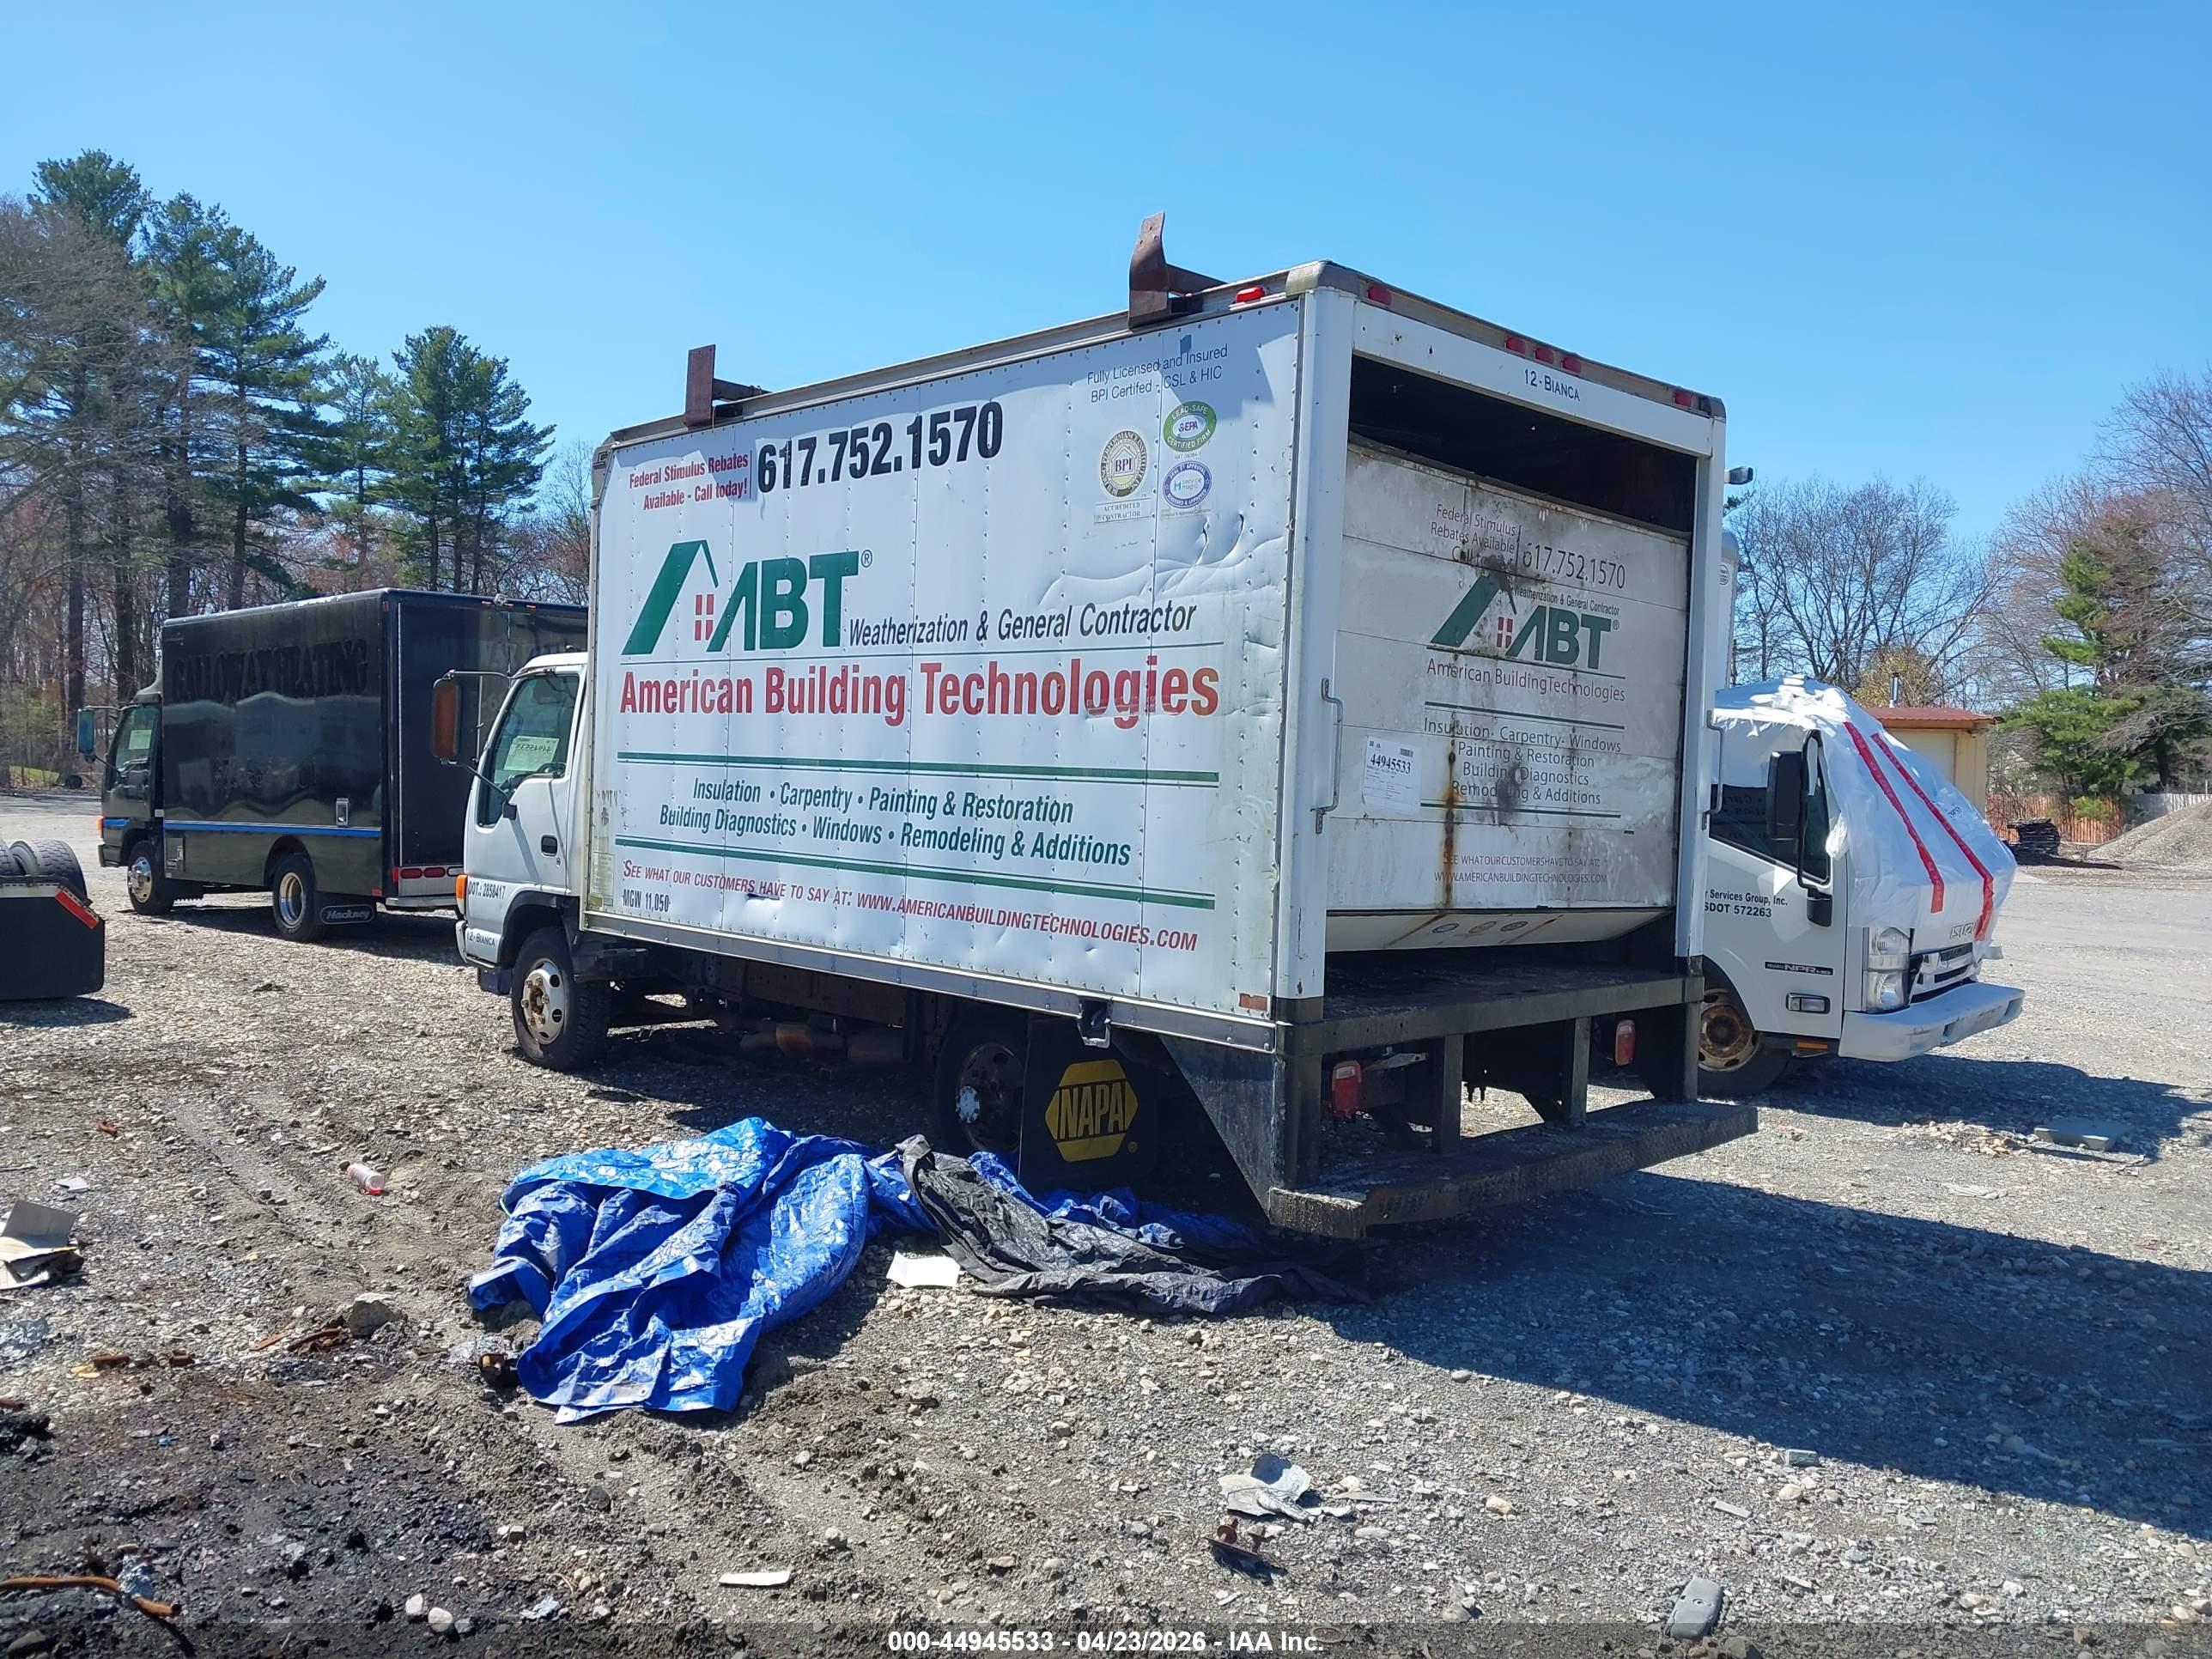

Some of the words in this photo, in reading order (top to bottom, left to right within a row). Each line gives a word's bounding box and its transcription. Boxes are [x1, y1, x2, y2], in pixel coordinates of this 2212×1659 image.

[1086, 371, 1110, 386] Fully
[1112, 359, 1160, 380] Licensed
[1164, 355, 1182, 370] and
[1185, 343, 1228, 366] Insured
[1091, 388, 1109, 404] BPI
[1164, 374, 1185, 389] CSL
[1188, 370, 1198, 384] &
[1200, 366, 1222, 382] HIC
[1171, 404, 1209, 420] LEAD-SAFE
[757, 401, 1004, 494] 617.752.1570
[1167, 435, 1196, 449] CERTIFIED
[1196, 428, 1211, 446] FIRM
[629, 468, 662, 489] Federal
[664, 459, 705, 483] Stimulus
[708, 453, 749, 474] Rebates
[1115, 458, 1132, 472] BPI
[643, 489, 684, 511] Available
[695, 483, 713, 502] Call
[715, 477, 748, 500] today!
[1103, 502, 1140, 513] ACCREDITED
[1102, 511, 1140, 521] CONTRACTOR
[1436, 503, 1473, 526] Federal
[1474, 514, 1516, 537] Stimulus
[1430, 521, 1469, 544] Rebates
[1471, 532, 1515, 554] Available
[1522, 542, 1626, 589] 617.752.1570
[1514, 585, 1559, 605] Weatherization
[1560, 593, 1565, 605] &
[1566, 594, 1589, 611] General
[1590, 600, 1620, 617] Contractor
[849, 612, 969, 647] Weatherization
[975, 610, 988, 641] &
[998, 605, 1073, 641] General
[1079, 600, 1198, 637] Contractor
[1426, 658, 1491, 684] American
[619, 669, 753, 714] American
[765, 664, 906, 727] Building
[920, 654, 1219, 729] Technologies
[1499, 726, 1561, 750] Carpentry
[1569, 733, 1622, 753] Windows
[1370, 752, 1411, 775] 44945533
[1458, 741, 1511, 762] Painting
[1514, 747, 1524, 761] &
[1527, 748, 1595, 769] Restoration
[1520, 766, 1589, 786] Diagnostics
[693, 777, 762, 804] Insulation
[780, 781, 853, 815] Carpentry
[868, 787, 938, 820] Painting
[943, 791, 957, 817] &
[962, 792, 1074, 824] Restoration
[1533, 786, 1542, 800] &
[1545, 787, 1601, 805] Additions
[659, 804, 711, 835] Building
[714, 808, 797, 837] Diagnostics
[812, 815, 883, 845] Windows
[901, 822, 1006, 860] Remodeling
[1010, 830, 1025, 857] &
[1030, 831, 1132, 866] Additions
[623, 889, 641, 909] MGW
[645, 893, 671, 913] 11,050
[645, 866, 671, 882] WHAT
[672, 870, 691, 885] OUR
[694, 872, 756, 893] CUSTOMERS
[758, 881, 787, 898] HAVE
[790, 884, 804, 899] TO
[807, 887, 829, 902] SAY
[833, 890, 853, 906] AT:
[856, 891, 1198, 951] WWW.AMERICANBUILDINGTECHNOLOGIES.COM
[1710, 888, 1743, 902] Services
[1745, 892, 1771, 907] Group,
[1773, 895, 1789, 907] Inc.
[1734, 904, 1772, 918] 572263
[326, 909, 370, 921] Hackney
[1784, 963, 1816, 974] NPR
[1060, 1080, 1124, 1140] NAPA
